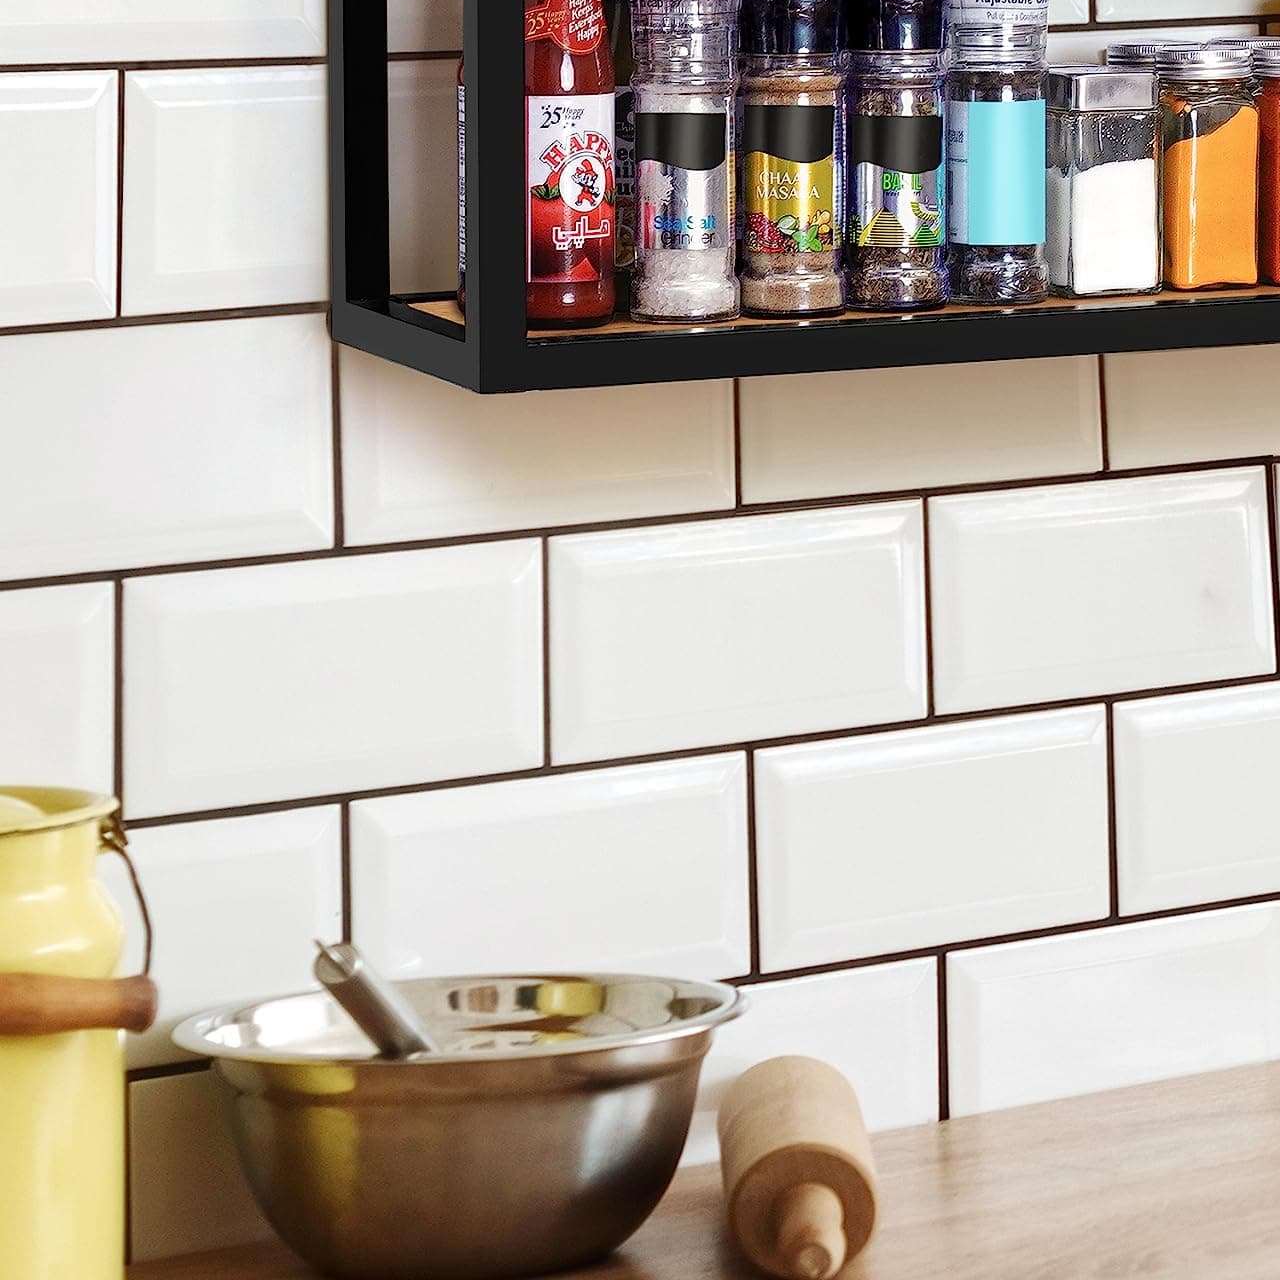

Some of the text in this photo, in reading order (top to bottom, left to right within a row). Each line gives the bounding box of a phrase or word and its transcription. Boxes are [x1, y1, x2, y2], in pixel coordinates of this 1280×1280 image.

[571, 4, 594, 21] Keeps
[527, 12, 545, 36] 25
[577, 24, 600, 41] Happy
[540, 107, 563, 129] 25
[539, 133, 615, 170] HAPPY
